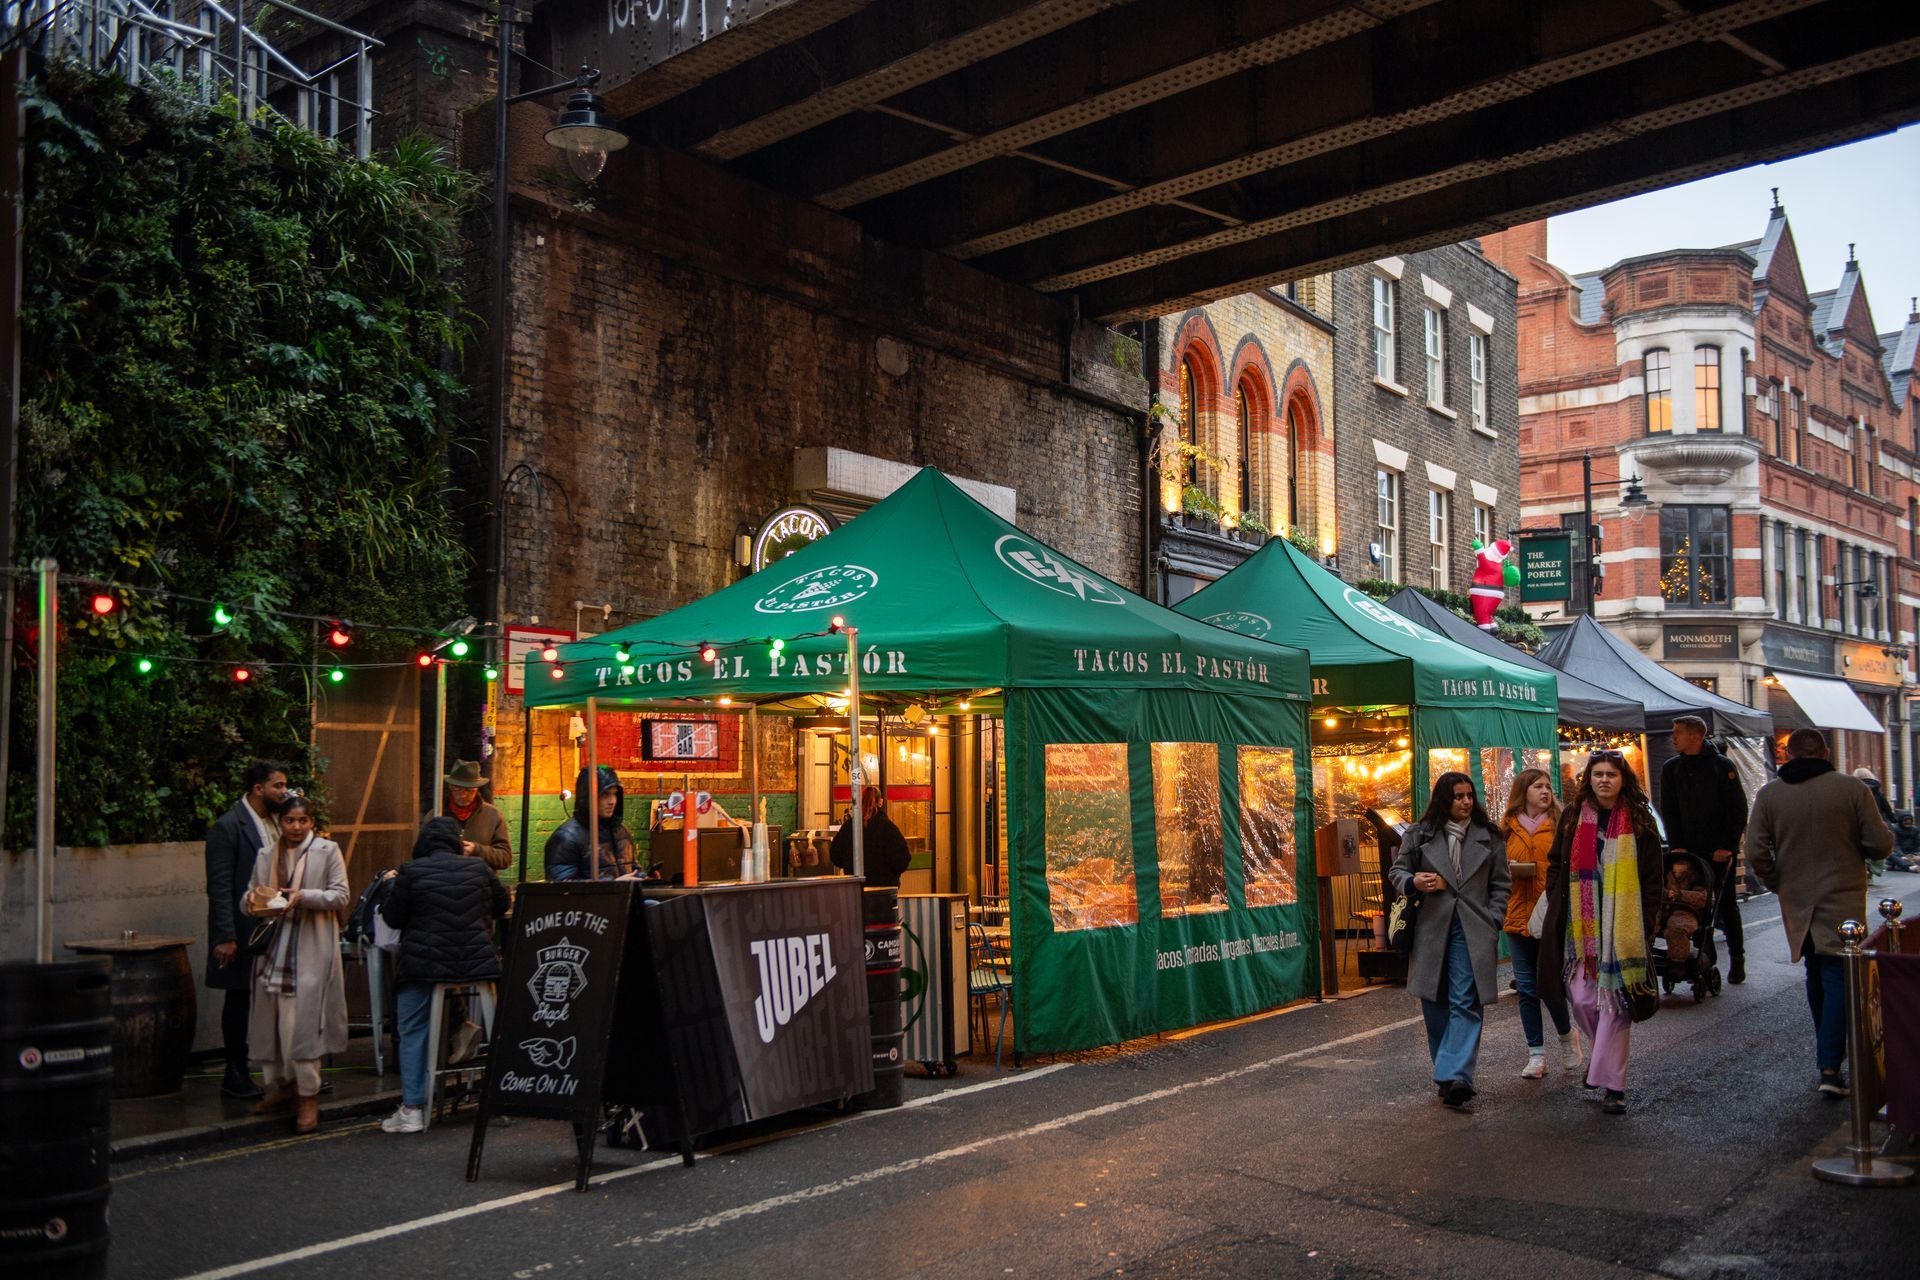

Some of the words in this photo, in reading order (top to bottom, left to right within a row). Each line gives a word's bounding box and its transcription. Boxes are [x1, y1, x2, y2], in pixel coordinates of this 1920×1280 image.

[768, 515, 823, 543] TACOS
[795, 568, 867, 585] TACOS
[1527, 561, 1562, 569] MARKET
[1527, 570, 1562, 579] PORTER
[1669, 634, 1732, 643] MONMOUTH
[595, 658, 693, 688] TACOS
[712, 655, 750, 680] EL
[1073, 649, 1149, 673] TACOS
[1162, 652, 1187, 674] EL
[1197, 656, 1270, 684] PASTÓR
[1441, 680, 1477, 696] TACOS
[1482, 680, 1495, 696] EL
[1499, 682, 1537, 702] PASTÓR
[523, 911, 563, 938] HOME
[564, 910, 583, 927] OF
[584, 911, 610, 935] THE
[544, 948, 582, 962] BURGER
[750, 932, 837, 1044] JUBEL
[532, 1000, 571, 1023] Shack
[500, 1070, 537, 1094] COME
[535, 1074, 557, 1094] ON
[557, 1073, 580, 1096] IN
